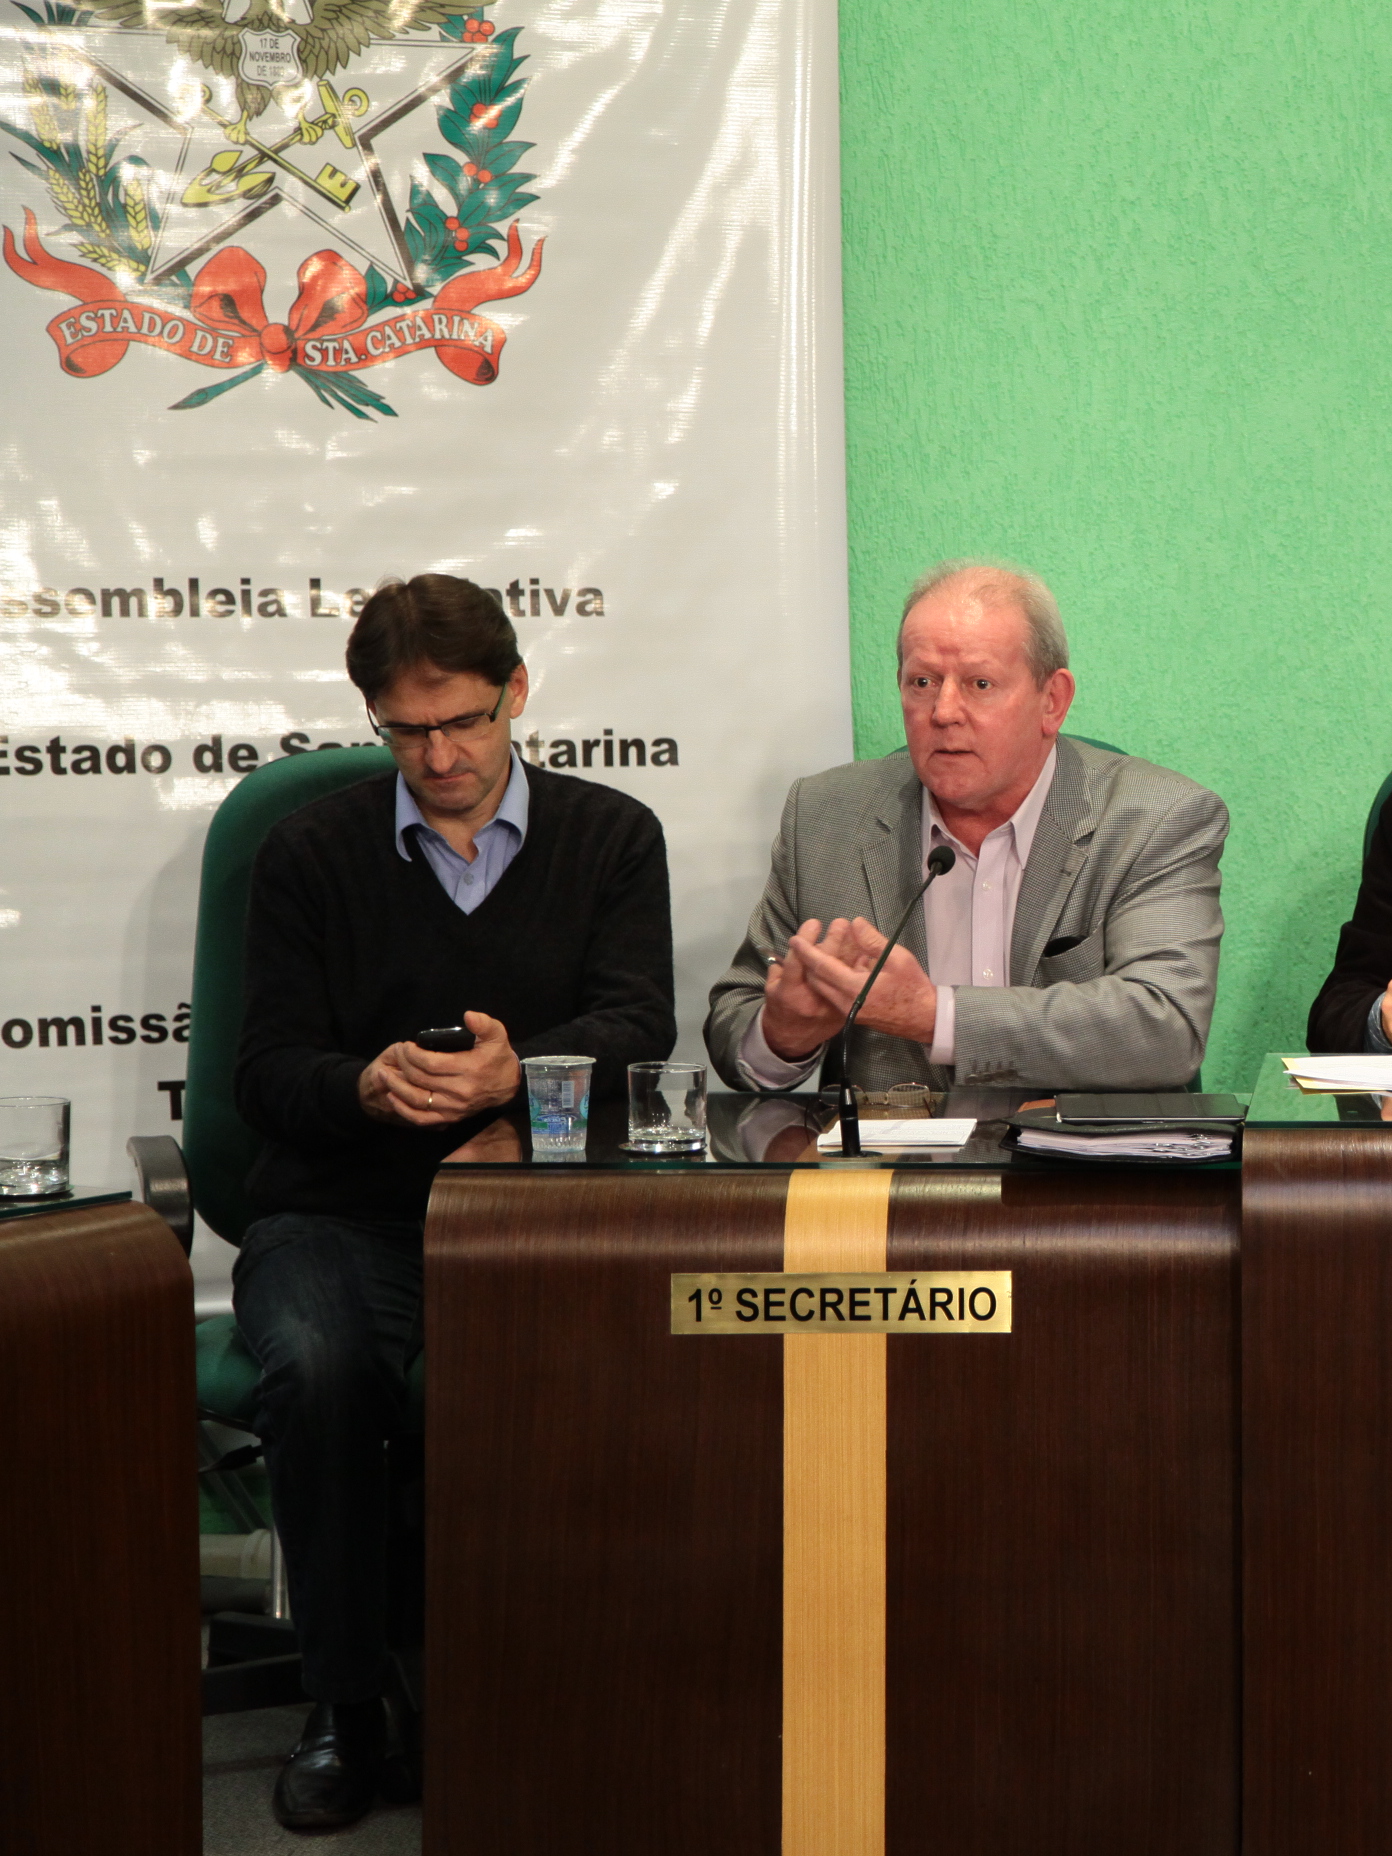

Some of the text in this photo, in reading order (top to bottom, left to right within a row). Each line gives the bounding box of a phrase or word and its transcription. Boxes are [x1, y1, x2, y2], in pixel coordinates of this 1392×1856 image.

[260, 38, 280, 49] 17 DE
[249, 51, 291, 63] NOVEMBRO
[256, 65, 267, 76] DE
[60, 309, 496, 367] ESTADO DE STA. CATARINA
[193, 735, 259, 773] de
[688, 1279, 998, 1322] 1º SECRETÁRIO
